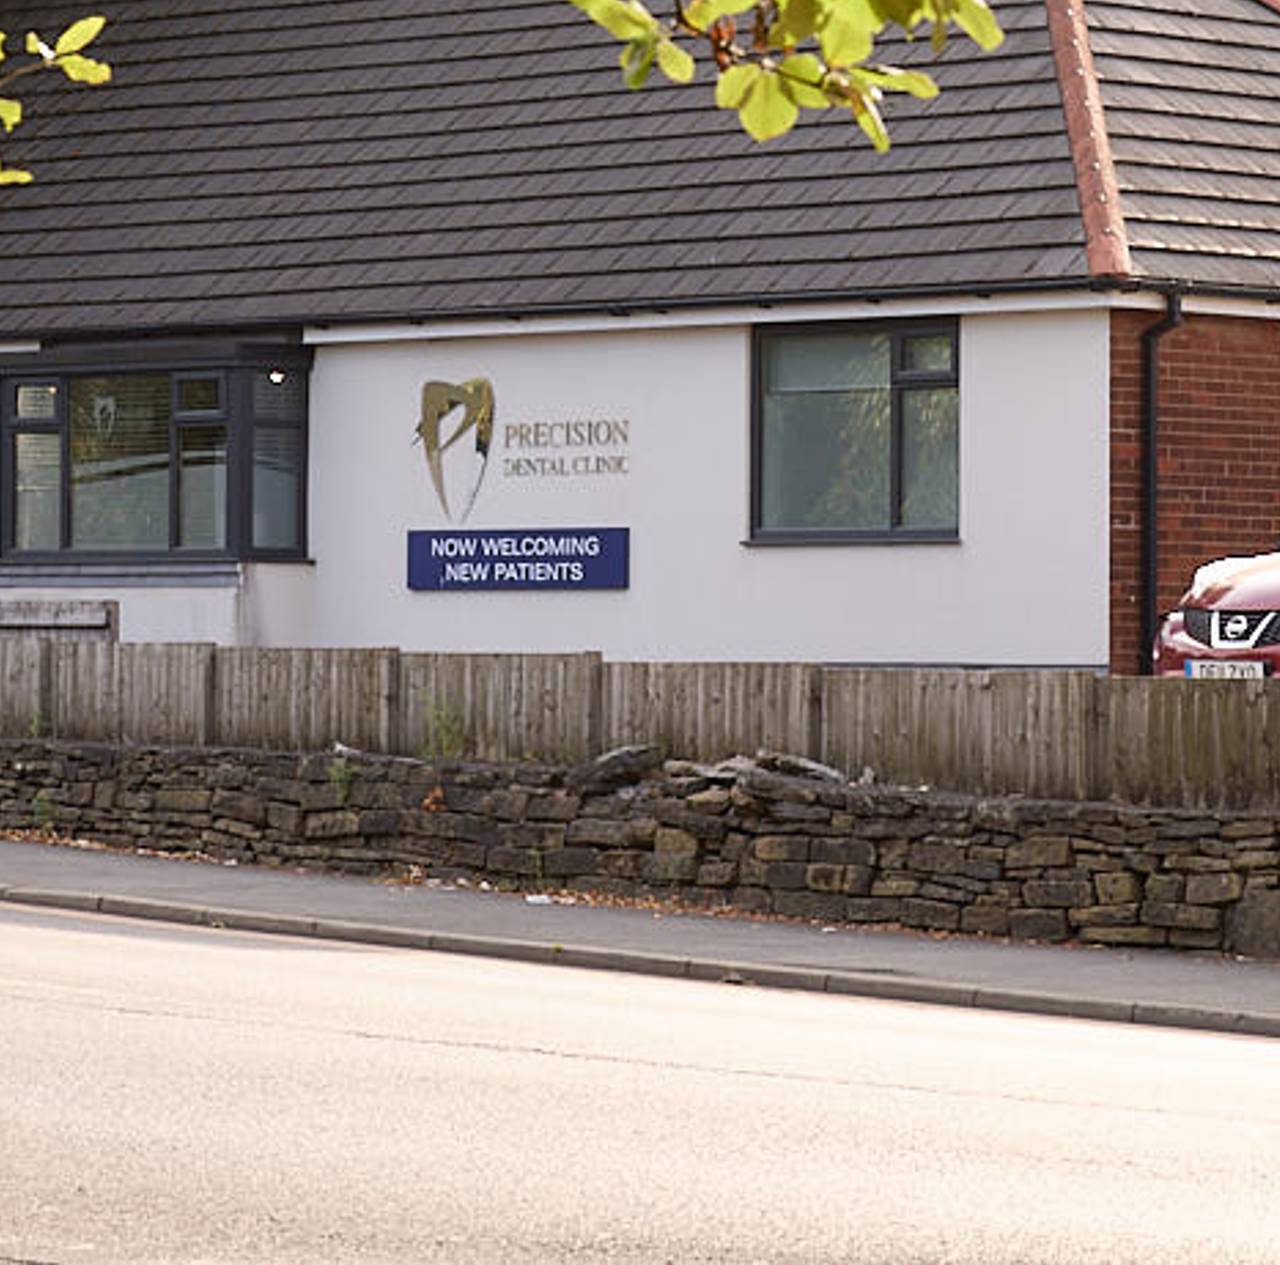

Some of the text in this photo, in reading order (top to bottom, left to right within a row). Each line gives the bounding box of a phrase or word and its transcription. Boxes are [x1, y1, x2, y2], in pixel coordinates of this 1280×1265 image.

[504, 420, 629, 448] PRECISION
[504, 456, 629, 477] DENTAL CLINIC
[431, 536, 600, 557] NOW WELCOMING
[445, 562, 584, 581] NEW PATIENTS
